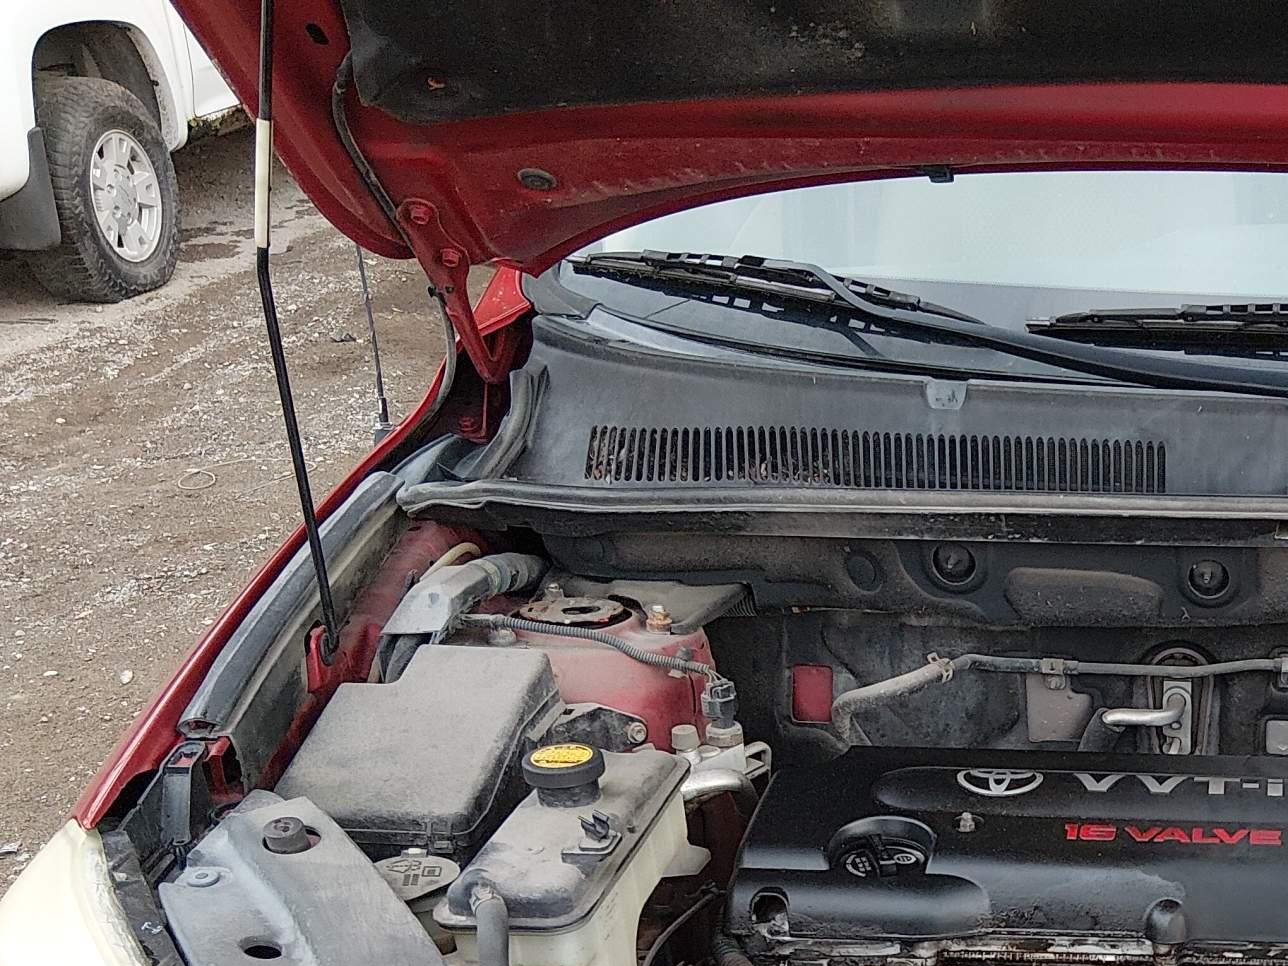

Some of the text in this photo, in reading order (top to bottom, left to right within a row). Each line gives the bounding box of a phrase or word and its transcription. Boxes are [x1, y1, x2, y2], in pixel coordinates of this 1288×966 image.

[1073, 772, 1284, 797] VVT-i
[1064, 823, 1283, 846] 16 VALVE
